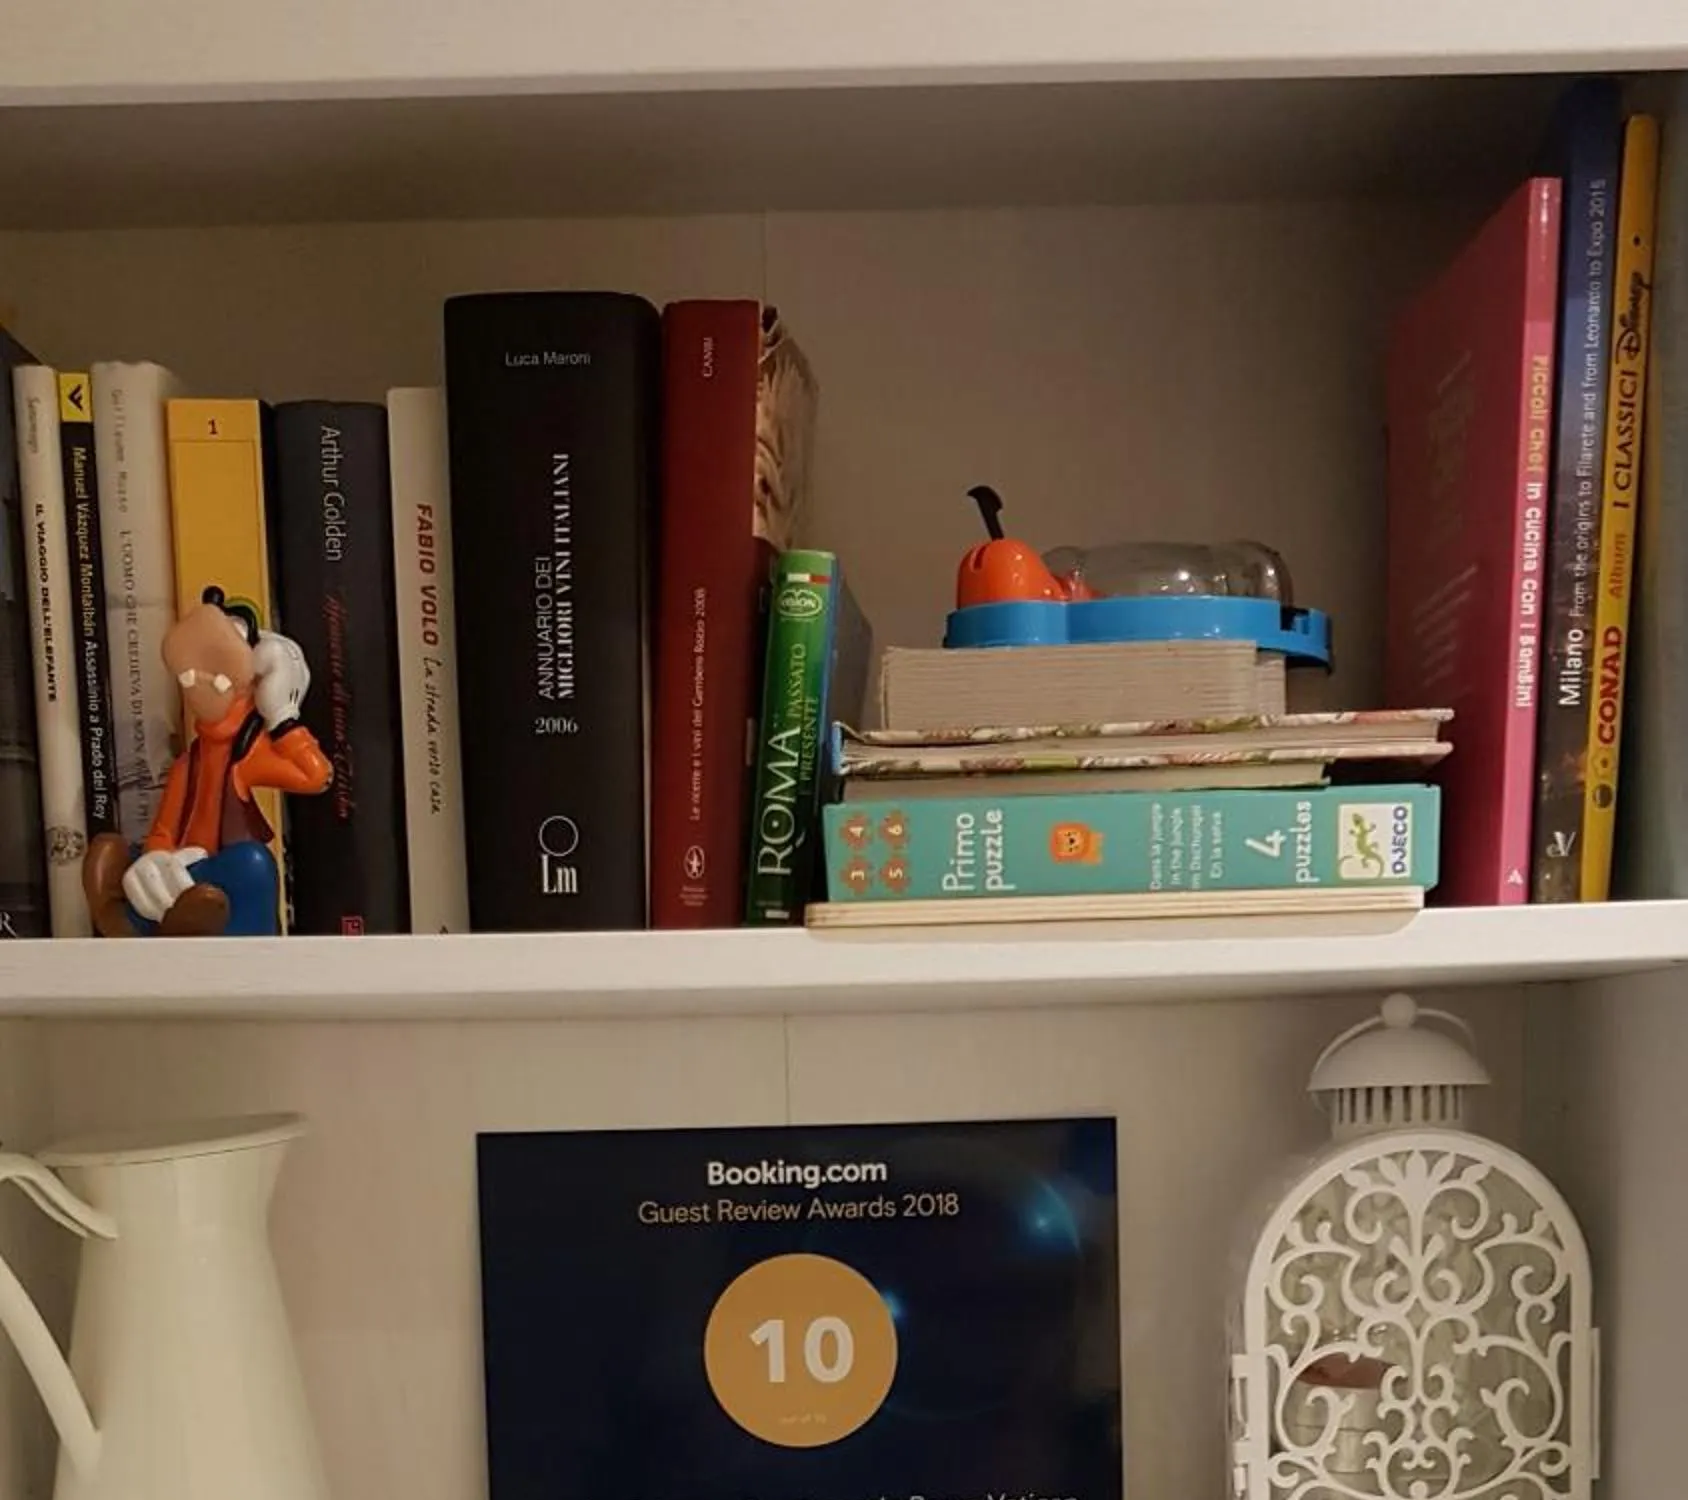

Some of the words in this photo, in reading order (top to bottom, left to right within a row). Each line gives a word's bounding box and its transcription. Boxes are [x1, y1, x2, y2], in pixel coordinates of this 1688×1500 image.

[1590, 178, 1607, 217] 2015
[1586, 221, 1606, 256] Expo
[1589, 259, 1603, 278] to
[1584, 281, 1601, 350] Leonardo
[1615, 270, 1652, 365] Disney
[504, 351, 541, 367] Luca
[543, 350, 592, 366] Maroni
[1581, 353, 1599, 389] from
[1530, 354, 1549, 420] Piccoli
[1583, 393, 1597, 419] and
[207, 419, 218, 435] 1
[1526, 428, 1545, 473] chef
[1576, 421, 1595, 477] Filarete
[1613, 369, 1639, 492] CLASSICI
[73, 446, 91, 499] Manuel
[321, 425, 344, 488] Arthur
[35, 503, 45, 517] IL
[552, 453, 572, 545] ITALIANI
[1526, 482, 1544, 501] in
[1579, 480, 1593, 496] to
[323, 492, 347, 562] Golden
[416, 503, 436, 575] FABIO
[1522, 507, 1542, 572] cucina
[1575, 502, 1595, 550] origins
[36, 521, 49, 584] VIAGGIO
[534, 556, 553, 589] DEI
[555, 551, 573, 595] VINI
[1572, 553, 1588, 578] the
[1608, 533, 1628, 599] Album
[420, 584, 440, 647] VOLO
[1519, 578, 1538, 616] con
[1568, 581, 1587, 617] From
[41, 587, 58, 702] DELL'ELEFANTE
[534, 593, 555, 701] ANNUARIO
[556, 601, 576, 700] MIGLIORI
[1558, 628, 1585, 705] Milano
[84, 640, 100, 712] Assassinio
[786, 643, 807, 719] PASSATO
[1597, 625, 1623, 745] CONAD
[425, 683, 441, 736] strada
[534, 716, 580, 735] 2006
[89, 727, 105, 770] Prado
[93, 773, 107, 794] del
[757, 727, 801, 876] ROMA
[93, 796, 108, 820] Rey
[850, 826, 864, 838] 4
[887, 823, 903, 837] 6
[942, 812, 975, 891] Primo
[980, 808, 1017, 891] puzzle
[1244, 828, 1287, 858] 4
[1288, 800, 1320, 883] puzzles
[1391, 806, 1409, 875] DJECO
[540, 853, 578, 894] Lm
[851, 868, 865, 881] 3
[888, 866, 903, 880] 5
[706, 1160, 888, 1189] Booking.com
[637, 1200, 712, 1224] Guest
[716, 1199, 801, 1222] Review
[806, 1196, 898, 1219] Awards
[902, 1192, 961, 1217] 2018
[750, 1316, 855, 1384] 10
